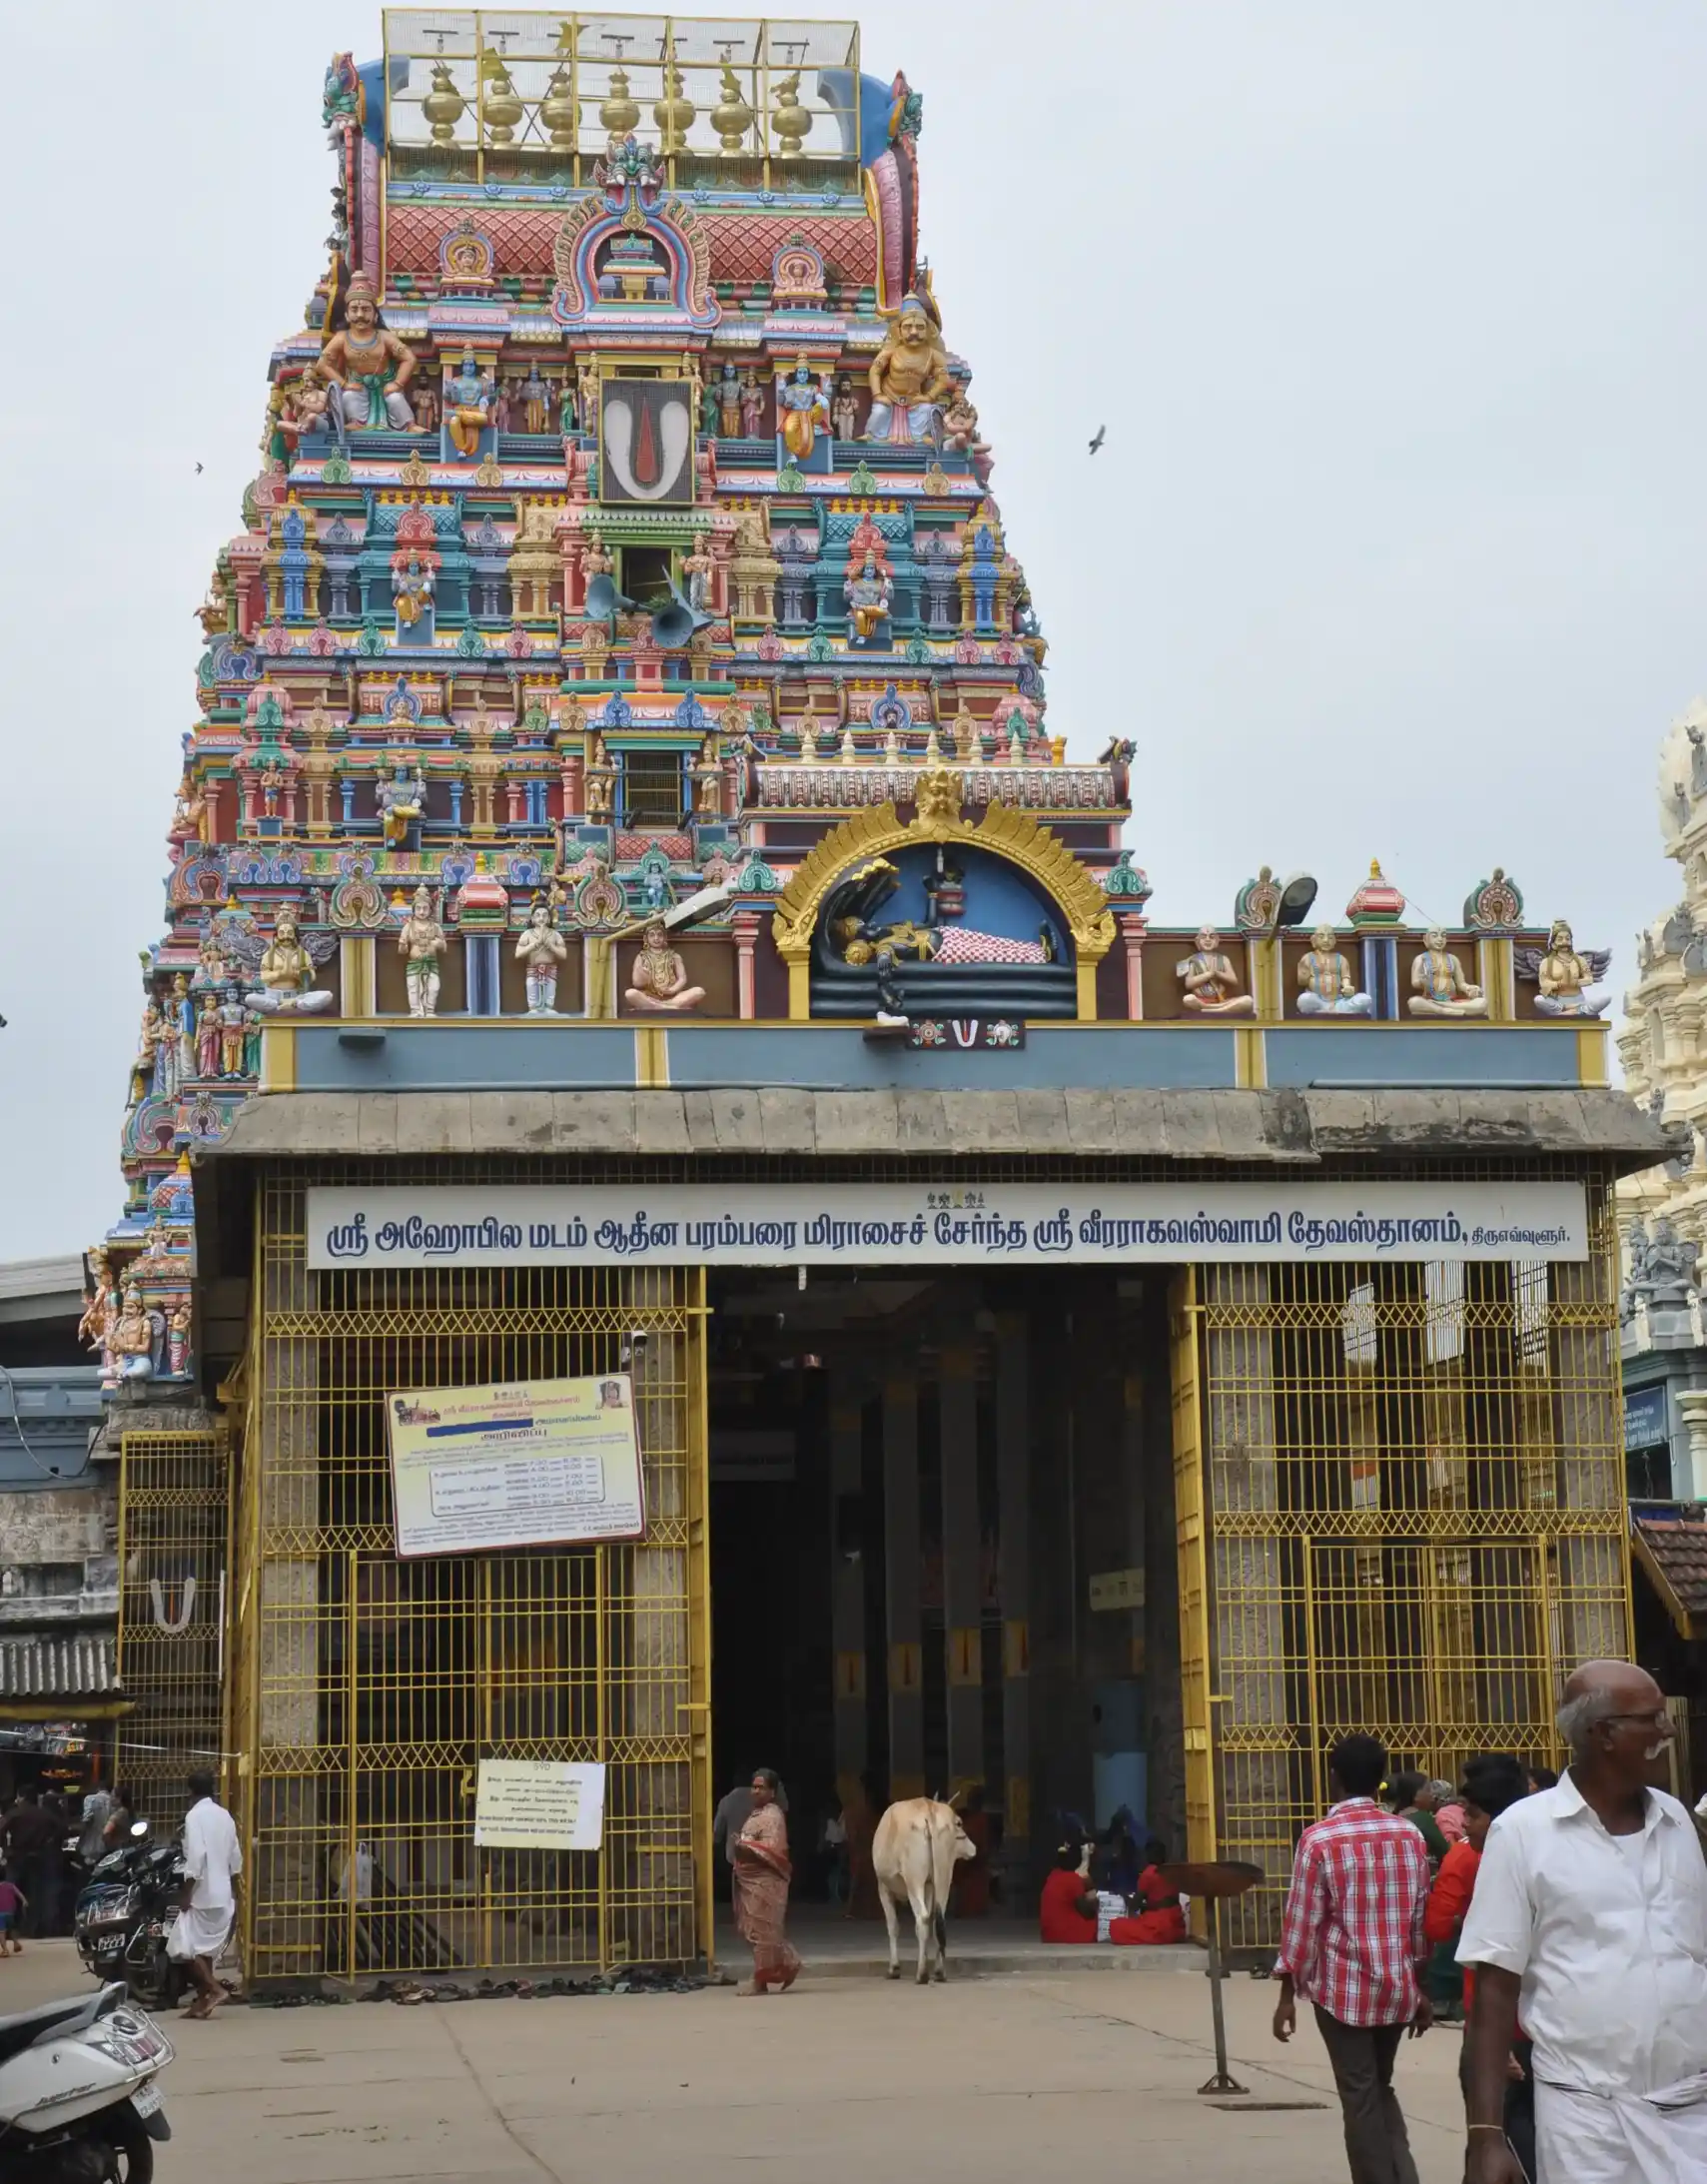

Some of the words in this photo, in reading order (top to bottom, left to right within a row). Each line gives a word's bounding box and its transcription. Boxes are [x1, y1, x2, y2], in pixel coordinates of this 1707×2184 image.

[327, 1212, 369, 1257] ஸ்ரீ
[375, 1215, 522, 1257] அஹோபில
[529, 1215, 587, 1248] மடம்
[593, 1210, 679, 1256] ஆதீன
[686, 1213, 798, 1251] பரம்பரை
[805, 1213, 928, 1251] மிராசைச்
[934, 1211, 1027, 1253] சேர்ந்த
[1033, 1208, 1074, 1252] ஸ்ரீ
[1079, 1209, 1282, 1249] வீரராகவஸ்வாமி
